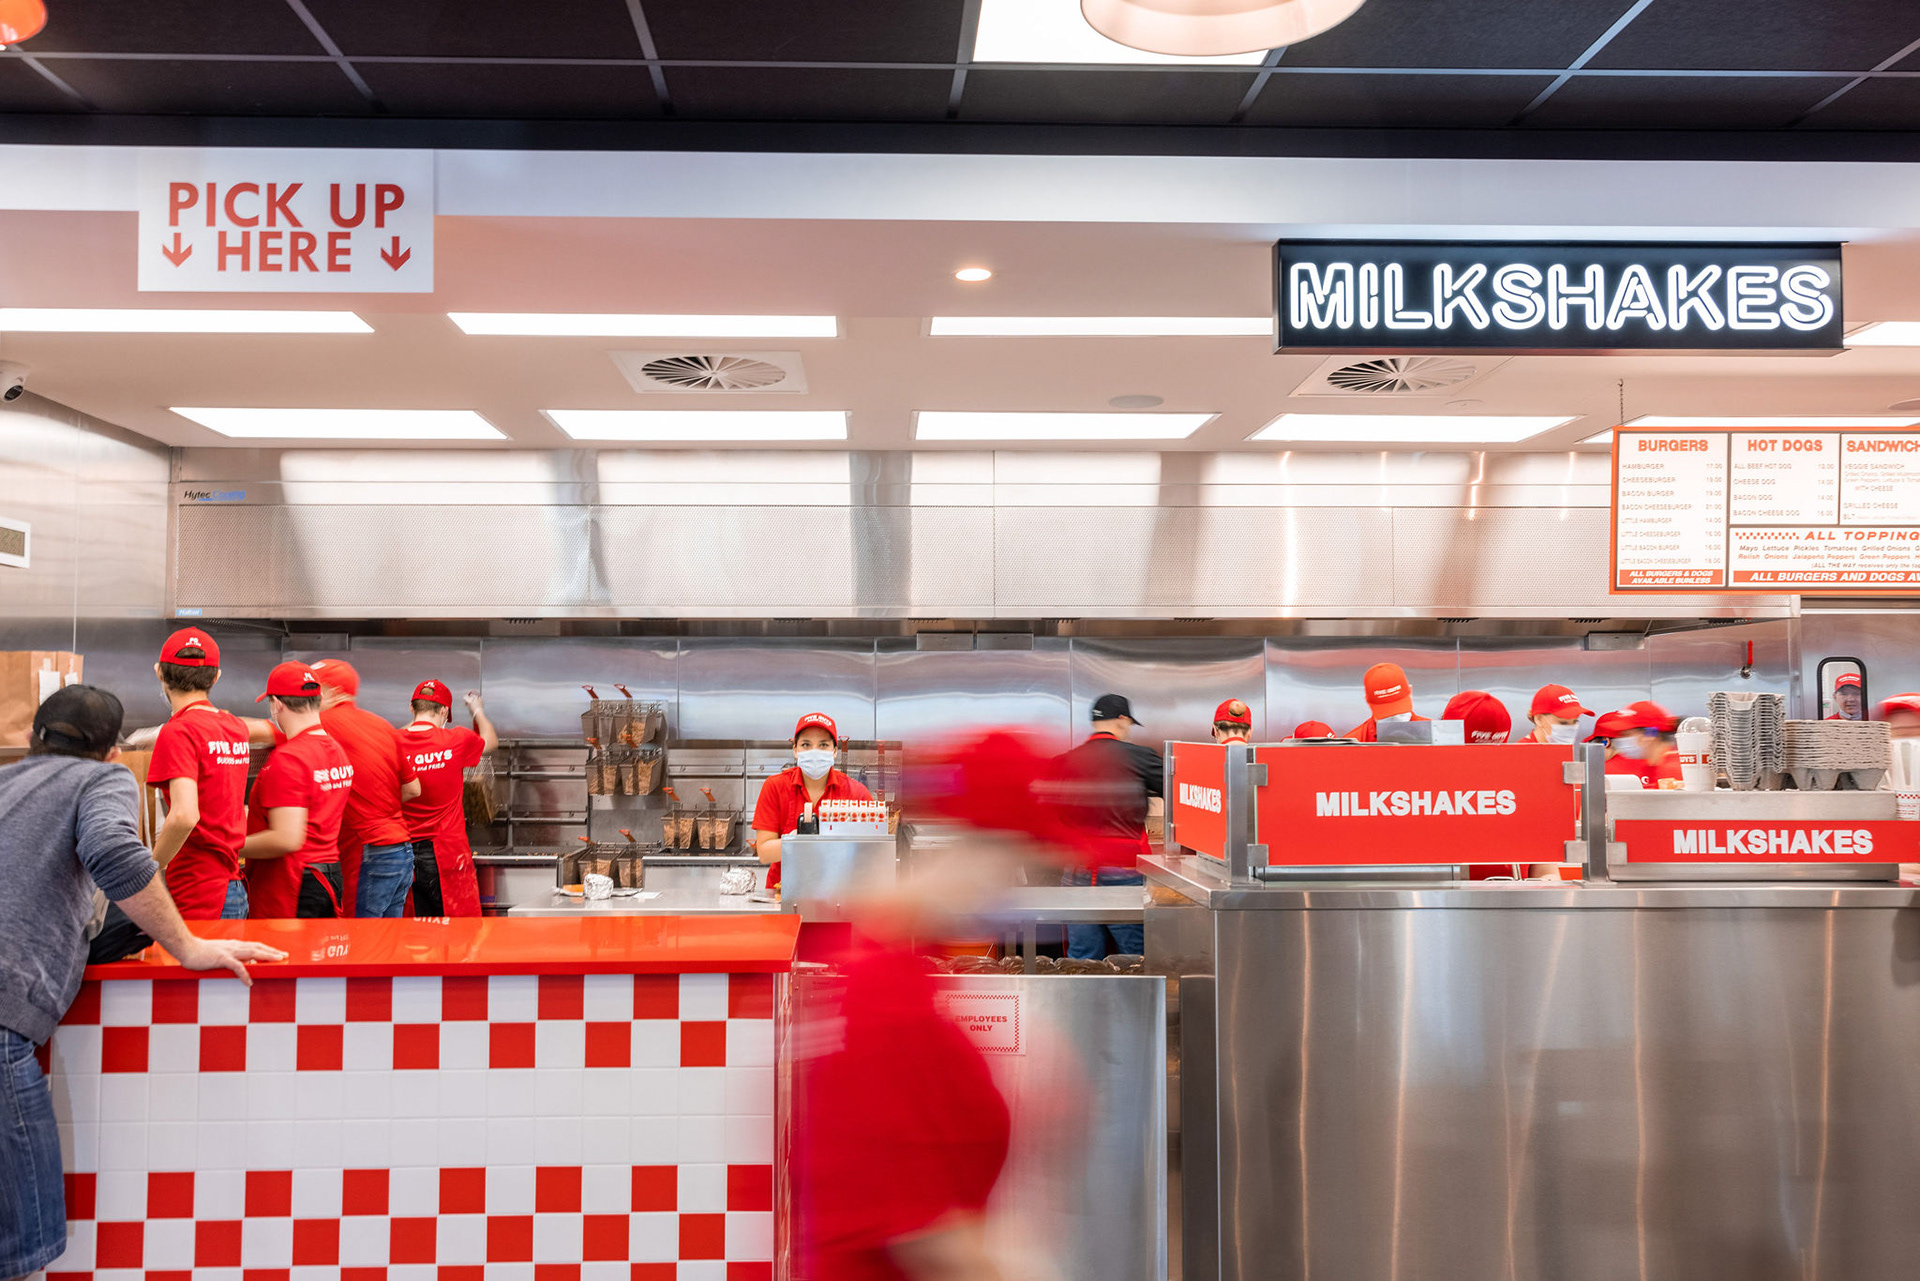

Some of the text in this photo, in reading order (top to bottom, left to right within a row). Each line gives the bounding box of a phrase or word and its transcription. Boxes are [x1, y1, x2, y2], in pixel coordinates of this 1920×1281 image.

[169, 182, 406, 228] PICK UP
[218, 231, 351, 272] HERE
[1289, 261, 1834, 332] MILKSHAKES
[1638, 439, 1709, 452] BURGERS
[1747, 439, 1823, 452] HOT DOGS
[184, 490, 210, 500] Hytec
[1804, 531, 1920, 541] ALL TOPPING
[1750, 572, 1775, 581] ALL
[1777, 572, 1837, 581] BURGERS
[1840, 573, 1867, 581] AND
[1869, 573, 1905, 581] DOGS
[414, 749, 452, 765] GUYS
[1179, 782, 1222, 814] MILKSHAKES
[1316, 789, 1516, 817] MILKSHAKES
[1673, 828, 1874, 856] MILKSHAKES
[970, 1024, 992, 1032] ONLY
